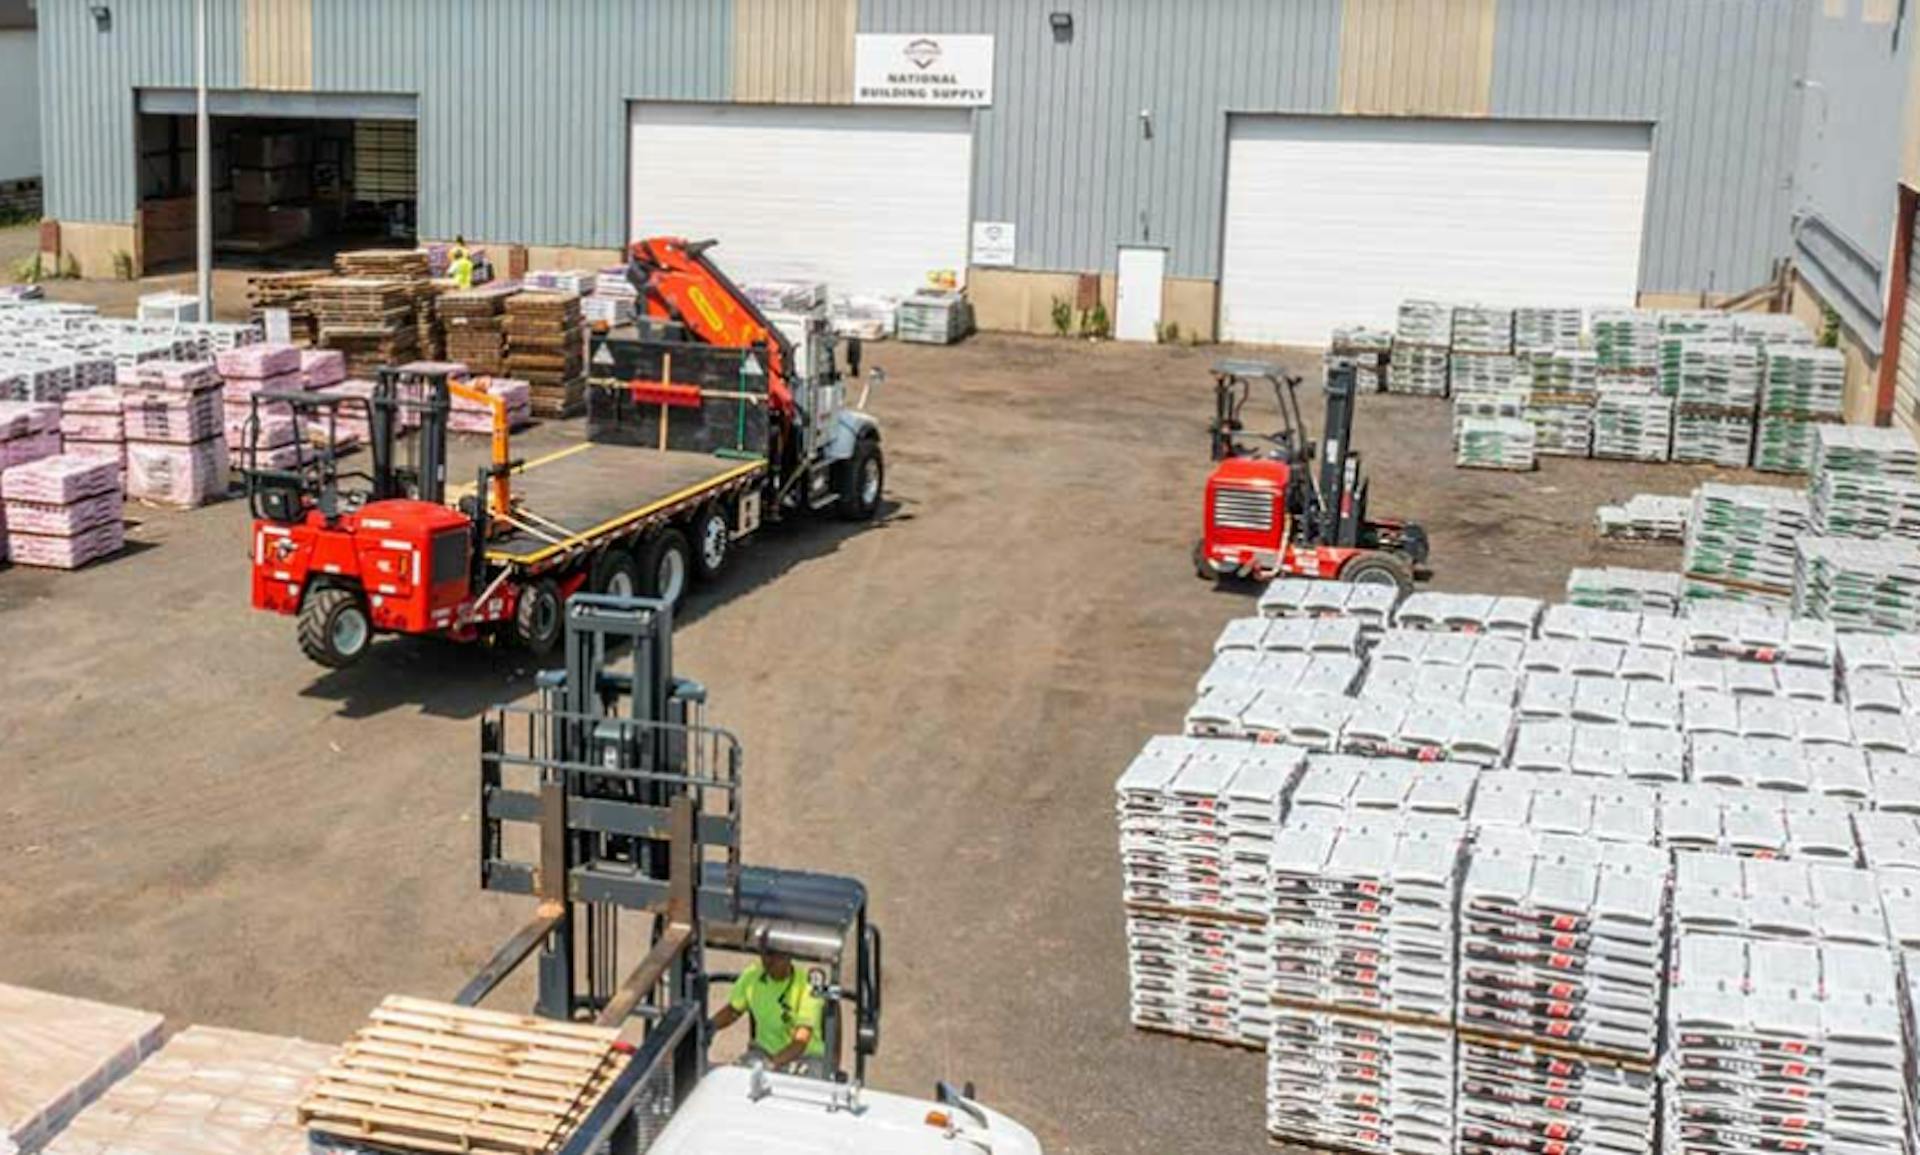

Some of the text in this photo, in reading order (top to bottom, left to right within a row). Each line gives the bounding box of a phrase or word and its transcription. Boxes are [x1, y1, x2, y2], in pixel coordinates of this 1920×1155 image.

[887, 73, 958, 84] NATIONAL
[860, 87, 986, 99] BUILDING SUPPLY
